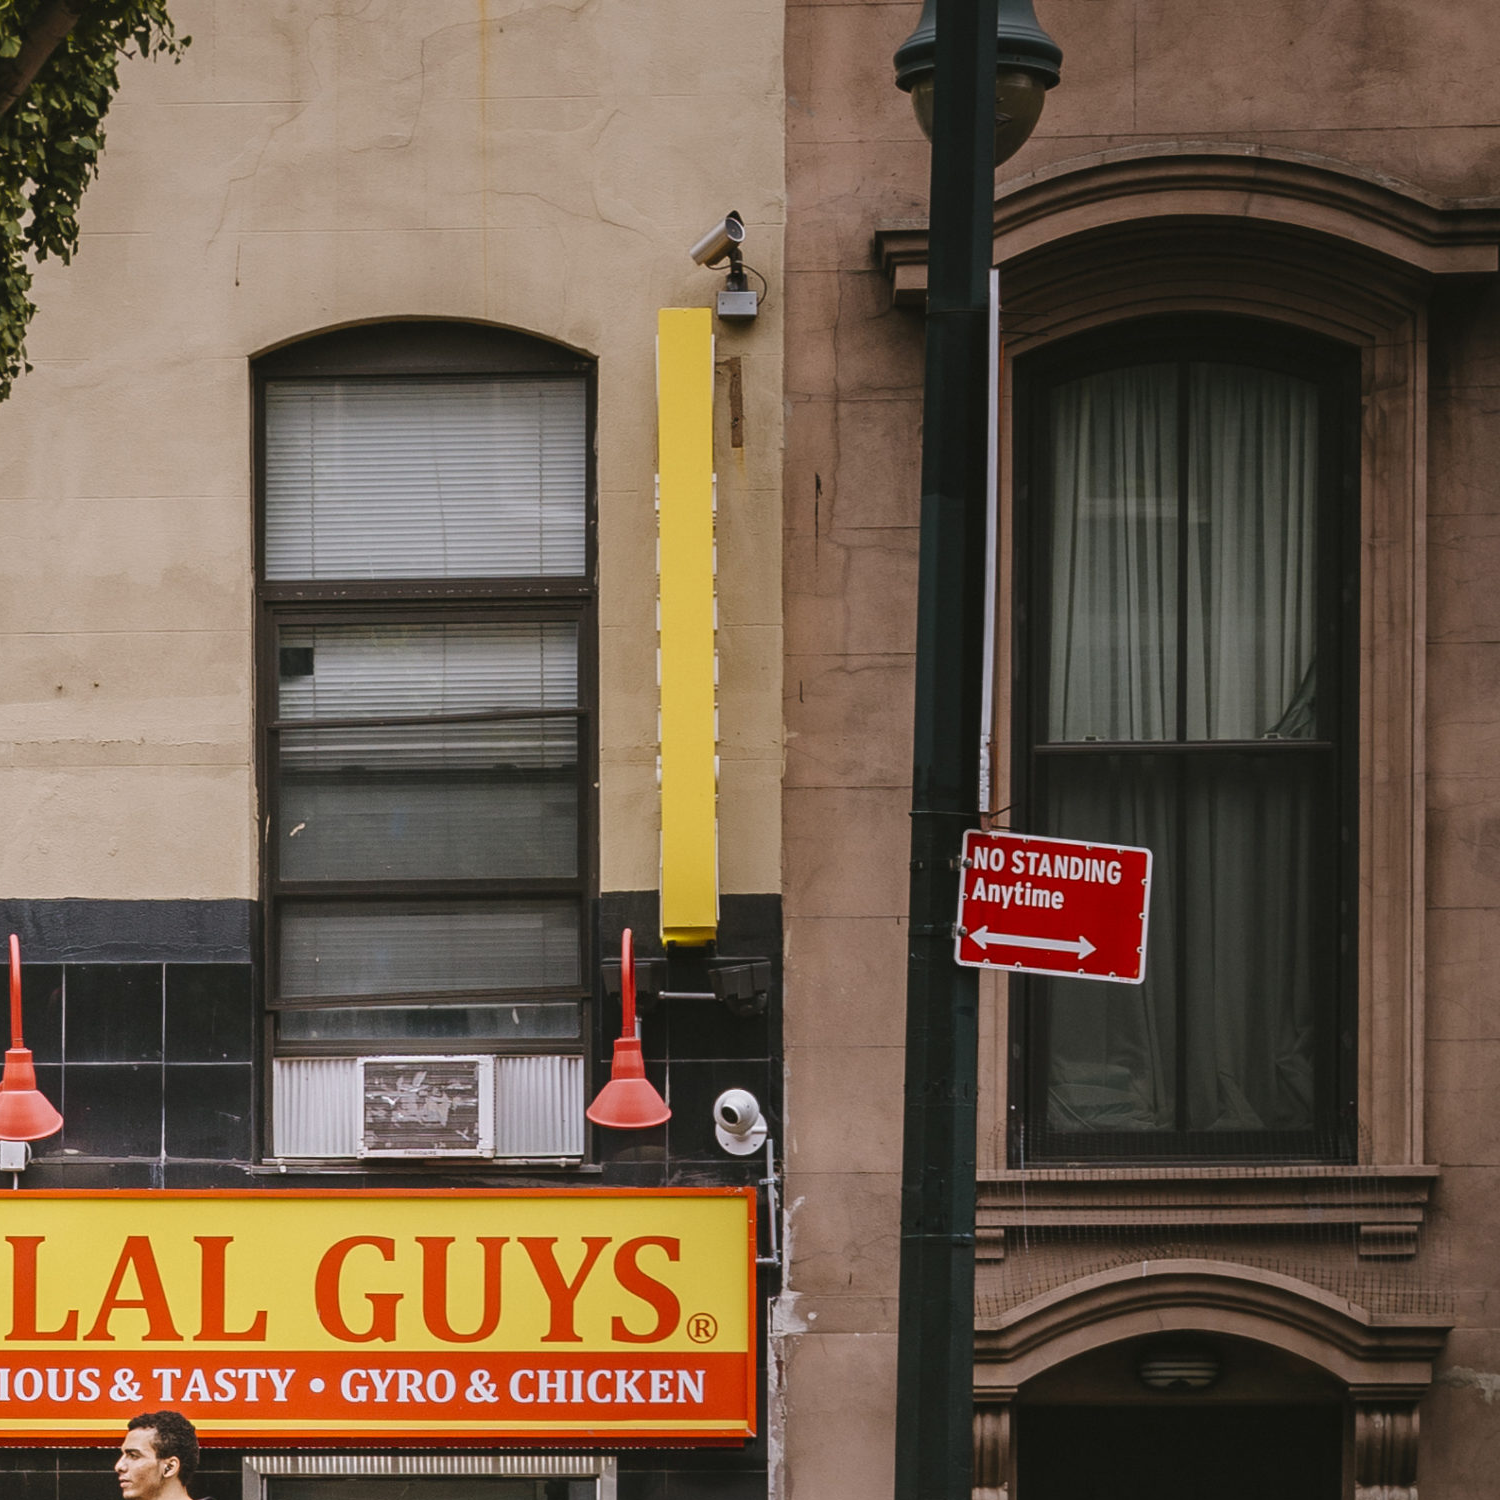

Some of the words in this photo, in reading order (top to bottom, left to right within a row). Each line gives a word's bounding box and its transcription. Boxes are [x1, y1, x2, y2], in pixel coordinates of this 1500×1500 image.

[972, 845, 1006, 872] NO
[1011, 850, 1122, 886] STANDING
[971, 876, 1065, 910] Anytime
[108, 1367, 145, 1403] &
[152, 1368, 296, 1403] TASTY
[340, 1368, 457, 1404] GYRO
[464, 1368, 500, 1404] &
[509, 1368, 706, 1404] CHICKEN
